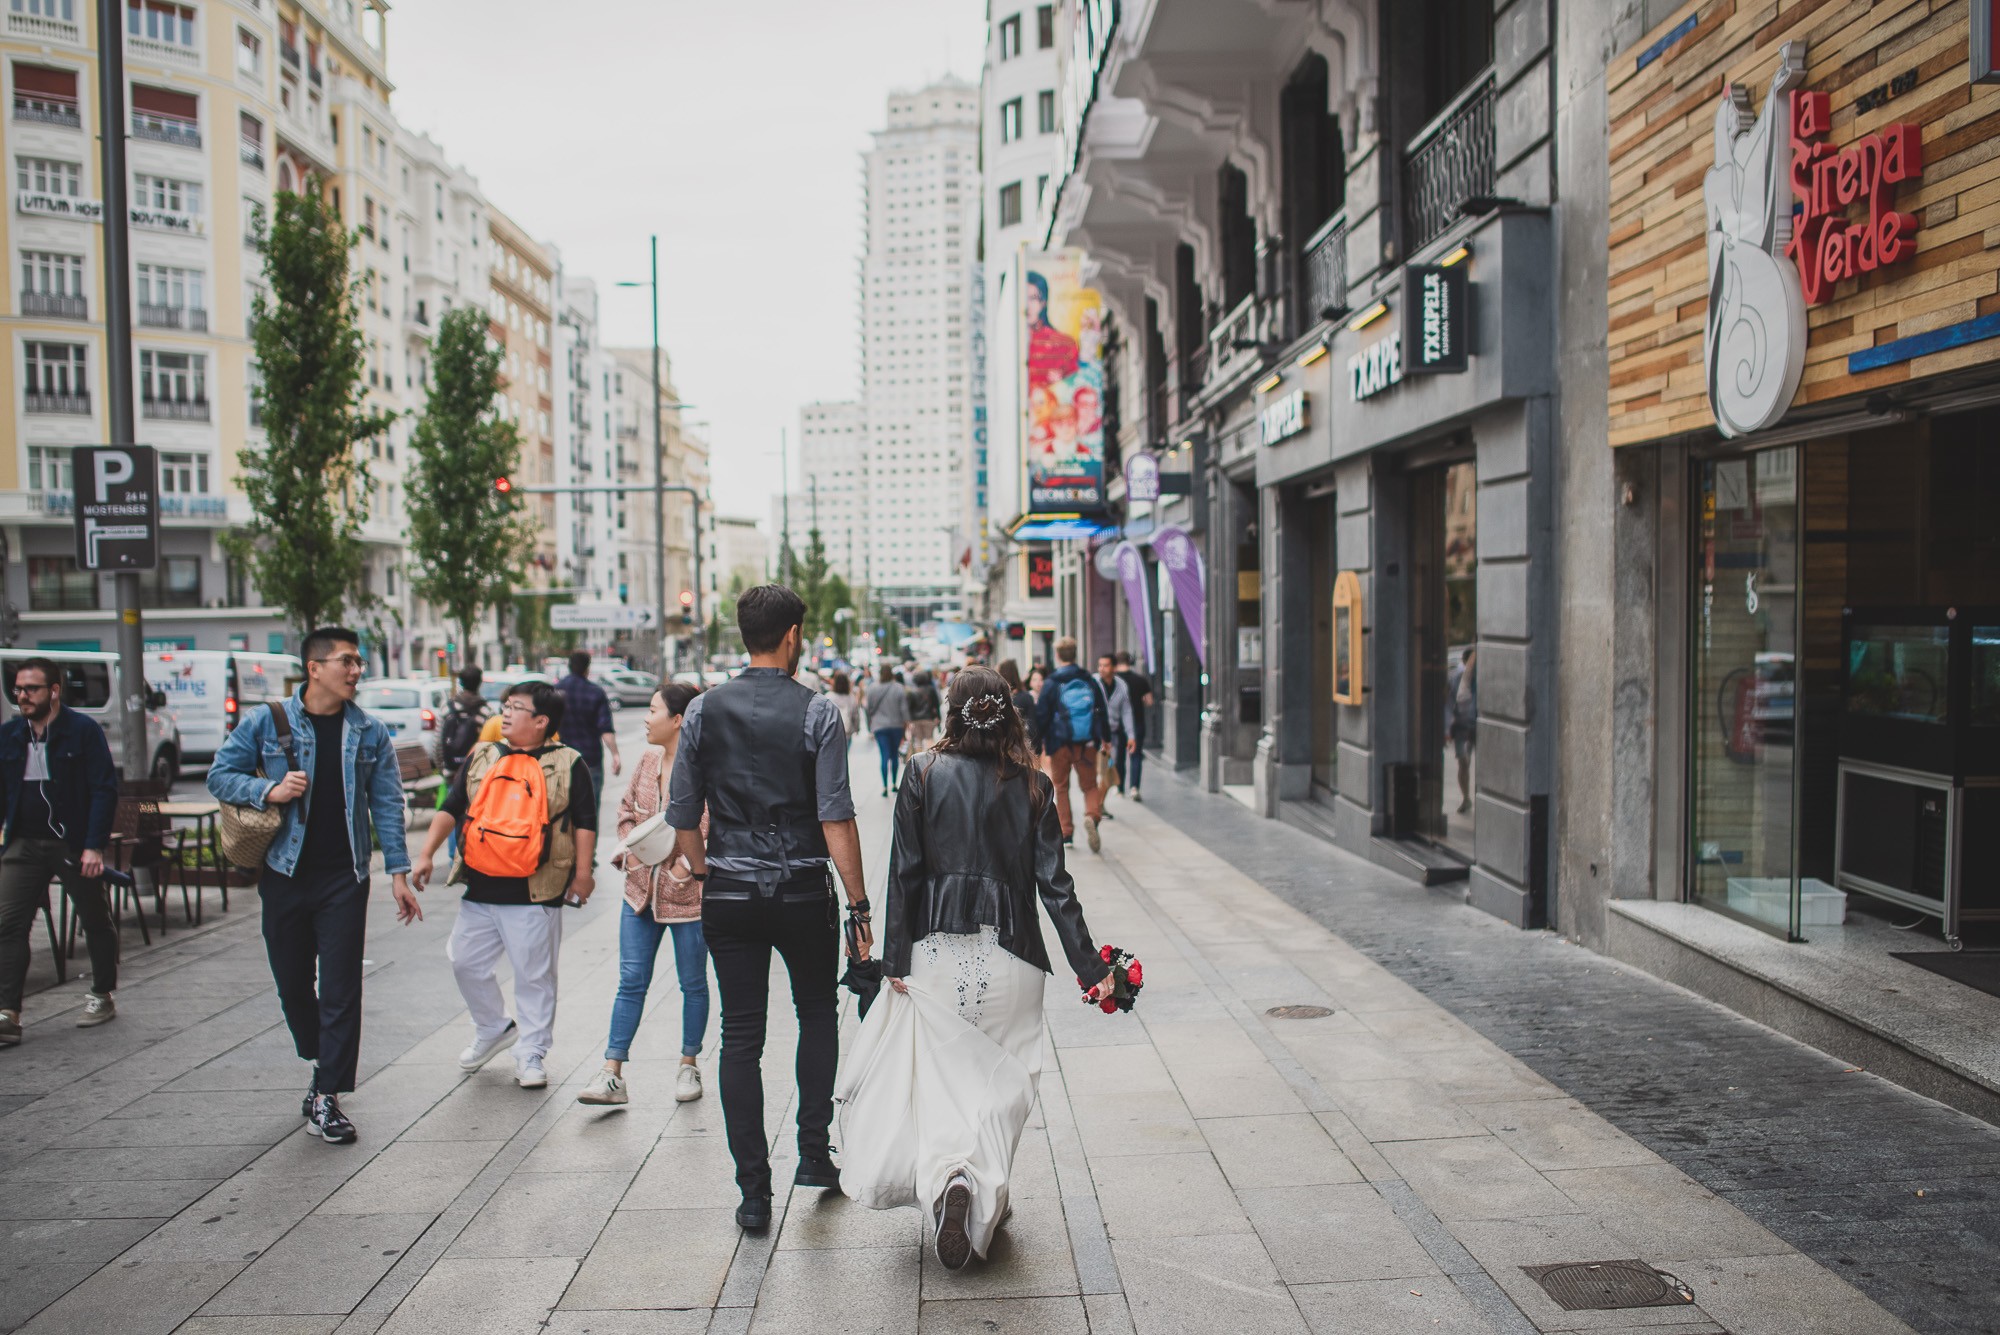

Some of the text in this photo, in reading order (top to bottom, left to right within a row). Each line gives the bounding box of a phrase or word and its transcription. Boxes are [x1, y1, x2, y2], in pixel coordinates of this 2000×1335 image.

[1789, 121, 1908, 236] Sirena
[1783, 209, 1904, 305] Verde
[1423, 272, 1441, 364] TXAPELA
[83, 504, 148, 516] MOSTENSES
[93, 450, 134, 503] P
